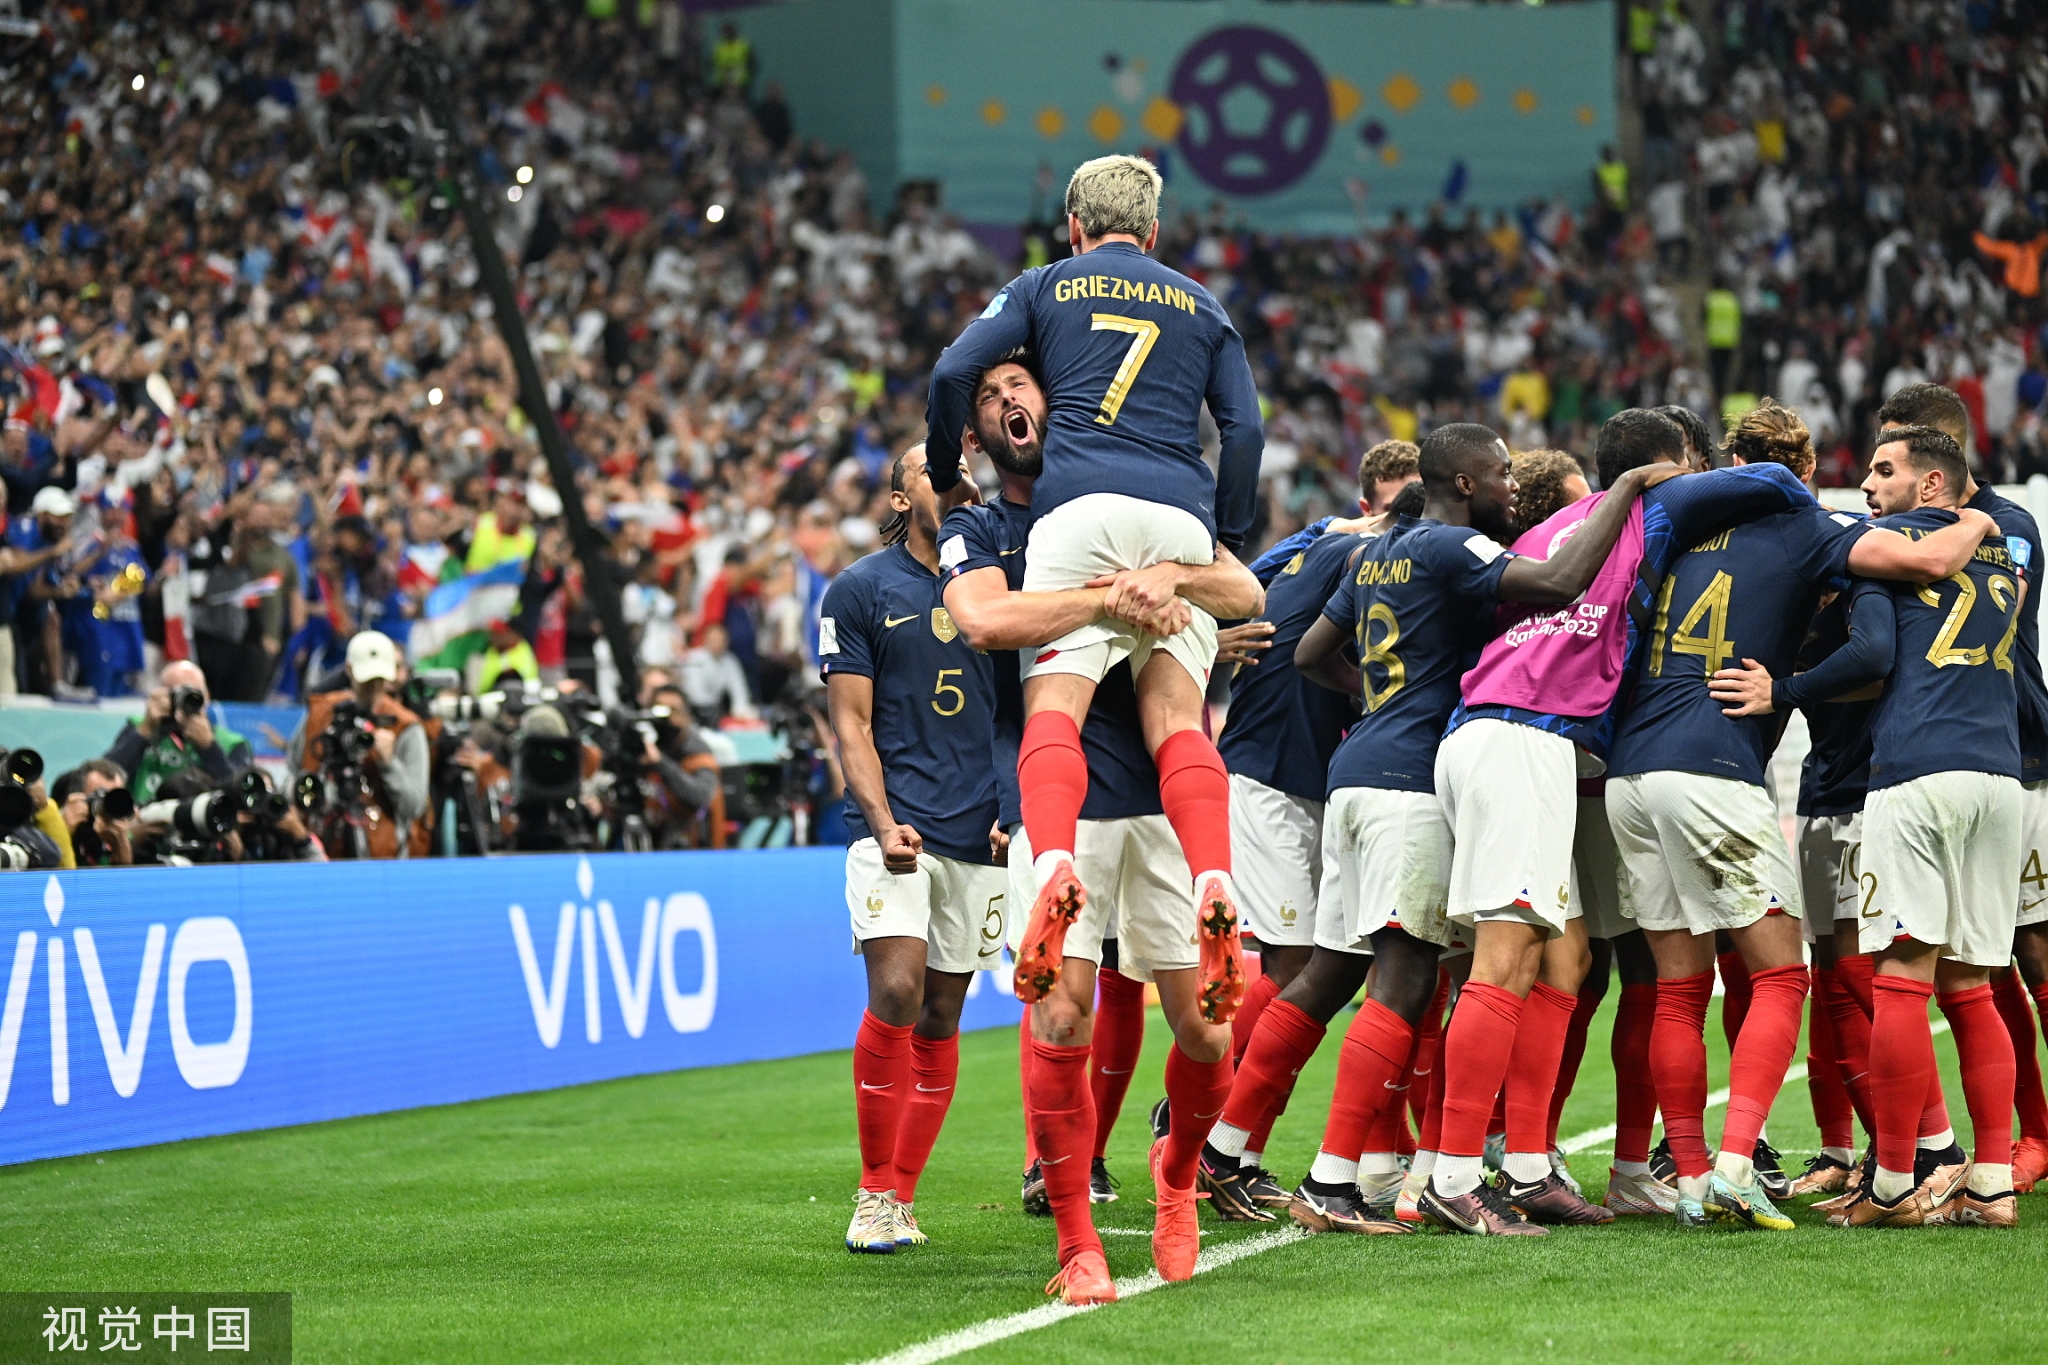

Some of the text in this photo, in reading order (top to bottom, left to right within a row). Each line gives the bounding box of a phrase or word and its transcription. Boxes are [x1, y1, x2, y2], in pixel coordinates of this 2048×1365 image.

[1054, 275, 1196, 315] GRIEZMANN
[1090, 312, 1161, 426] 7
[1578, 603, 1608, 619] CUP
[1648, 569, 1736, 682] 14
[931, 668, 965, 717] 5
[981, 894, 1005, 940] 5
